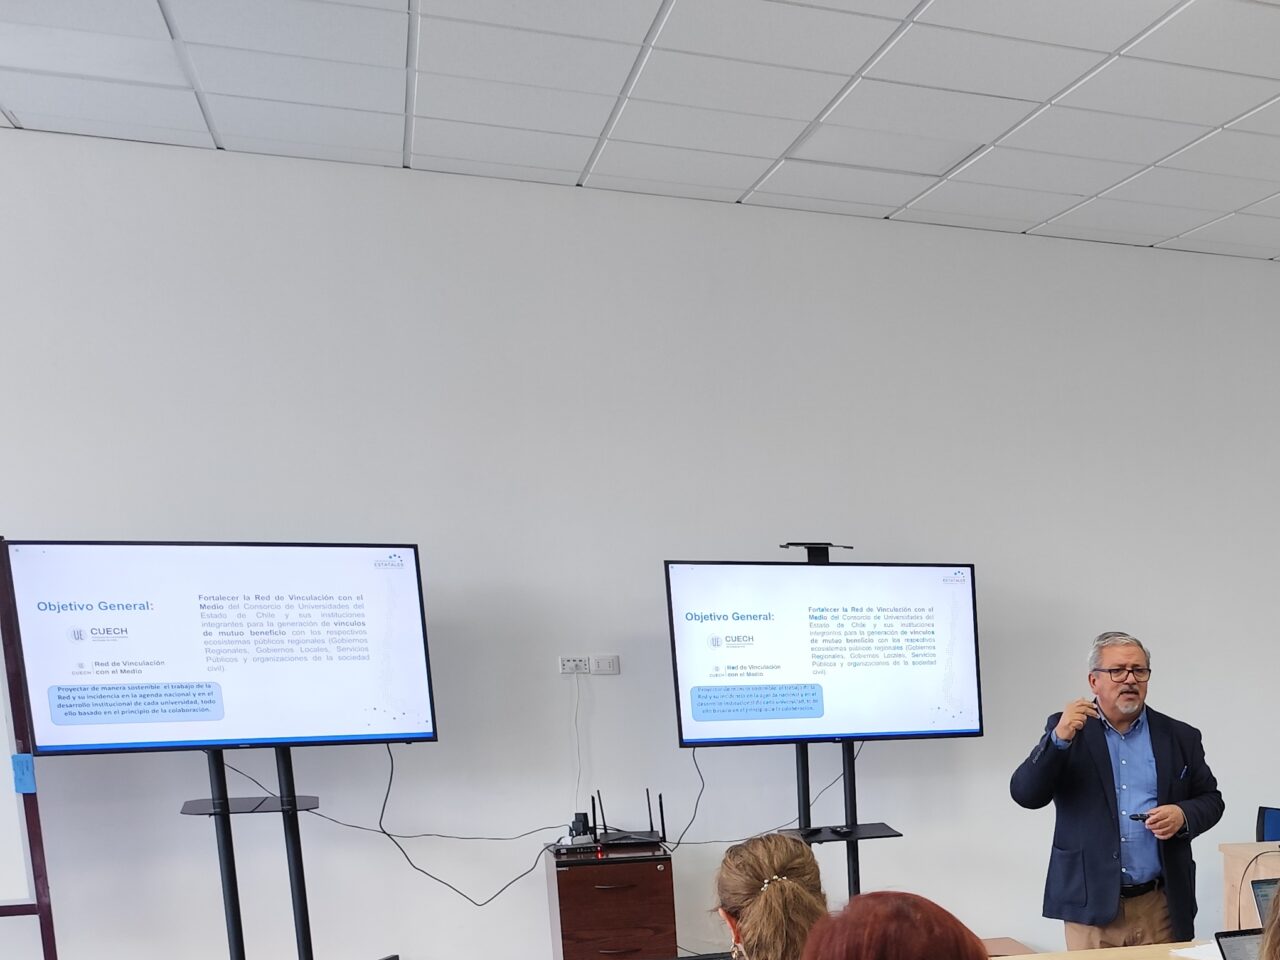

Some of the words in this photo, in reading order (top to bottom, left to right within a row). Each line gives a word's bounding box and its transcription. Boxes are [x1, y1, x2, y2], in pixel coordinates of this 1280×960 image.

[37, 601, 94, 614] Objetivo
[98, 601, 154, 610] General:
[685, 612, 729, 623] Objetivo
[732, 612, 775, 621] General:
[90, 627, 128, 636] CUECH
